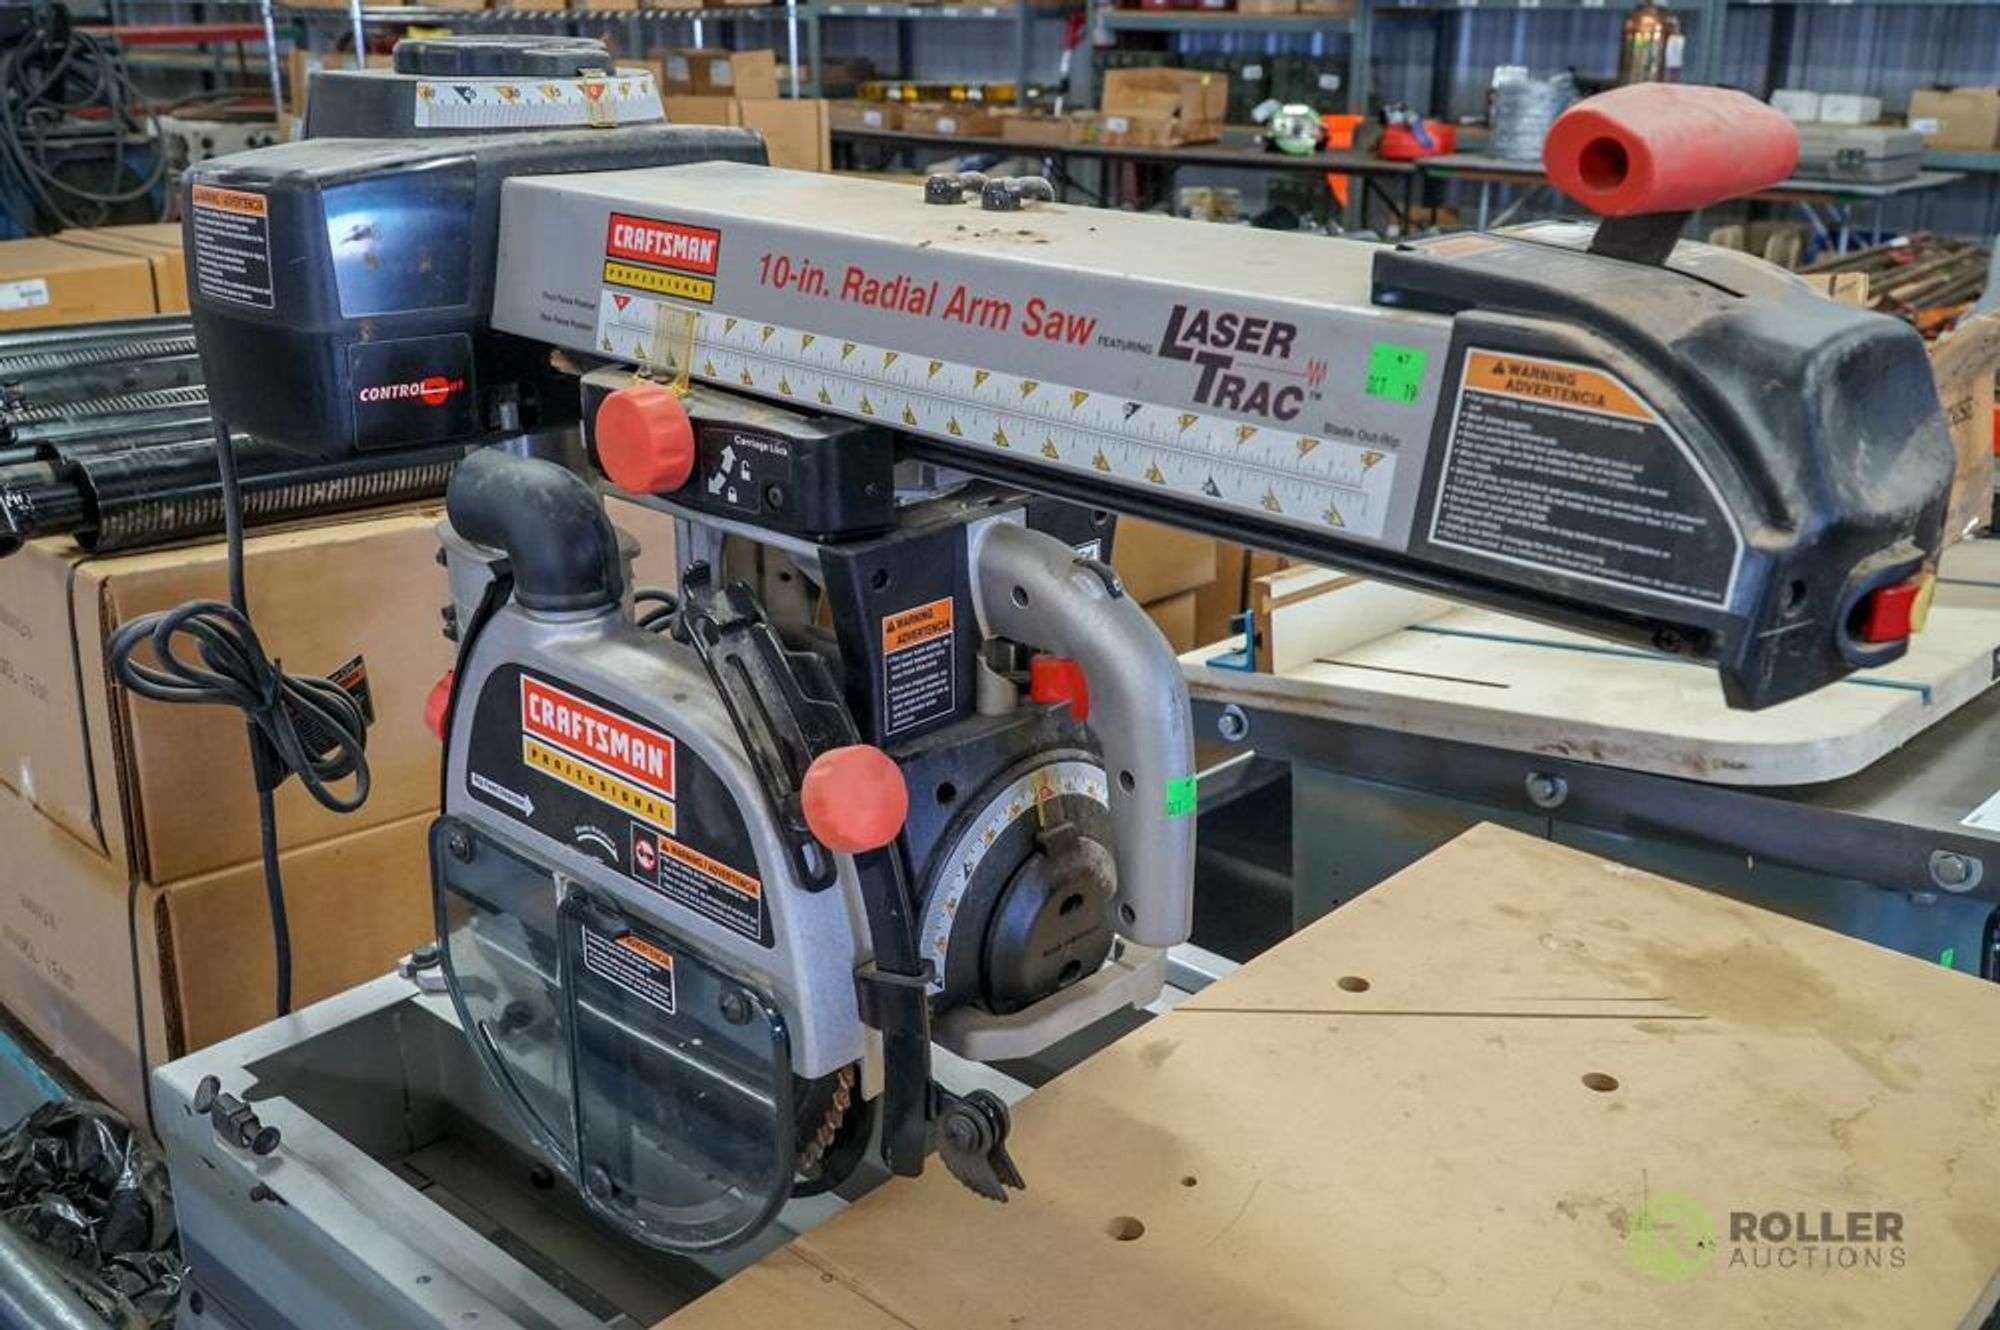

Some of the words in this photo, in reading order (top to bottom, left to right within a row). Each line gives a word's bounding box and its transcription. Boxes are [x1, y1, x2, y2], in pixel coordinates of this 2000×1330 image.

[614, 224, 713, 263] CRAFTSMAN
[758, 253, 829, 297] 10-in.
[841, 266, 938, 316] Radial
[943, 286, 1012, 331] Arm
[1022, 298, 1097, 346] Saw
[1098, 335, 1152, 355] FEATURING
[1158, 305, 1297, 360] LASER
[1192, 351, 1305, 421] TRAC
[1506, 378, 1607, 407] ADVERTENCIA
[1509, 364, 1576, 386] WARNING
[734, 435, 769, 452] Carriage
[528, 691, 665, 779] CRAFTSMAN
